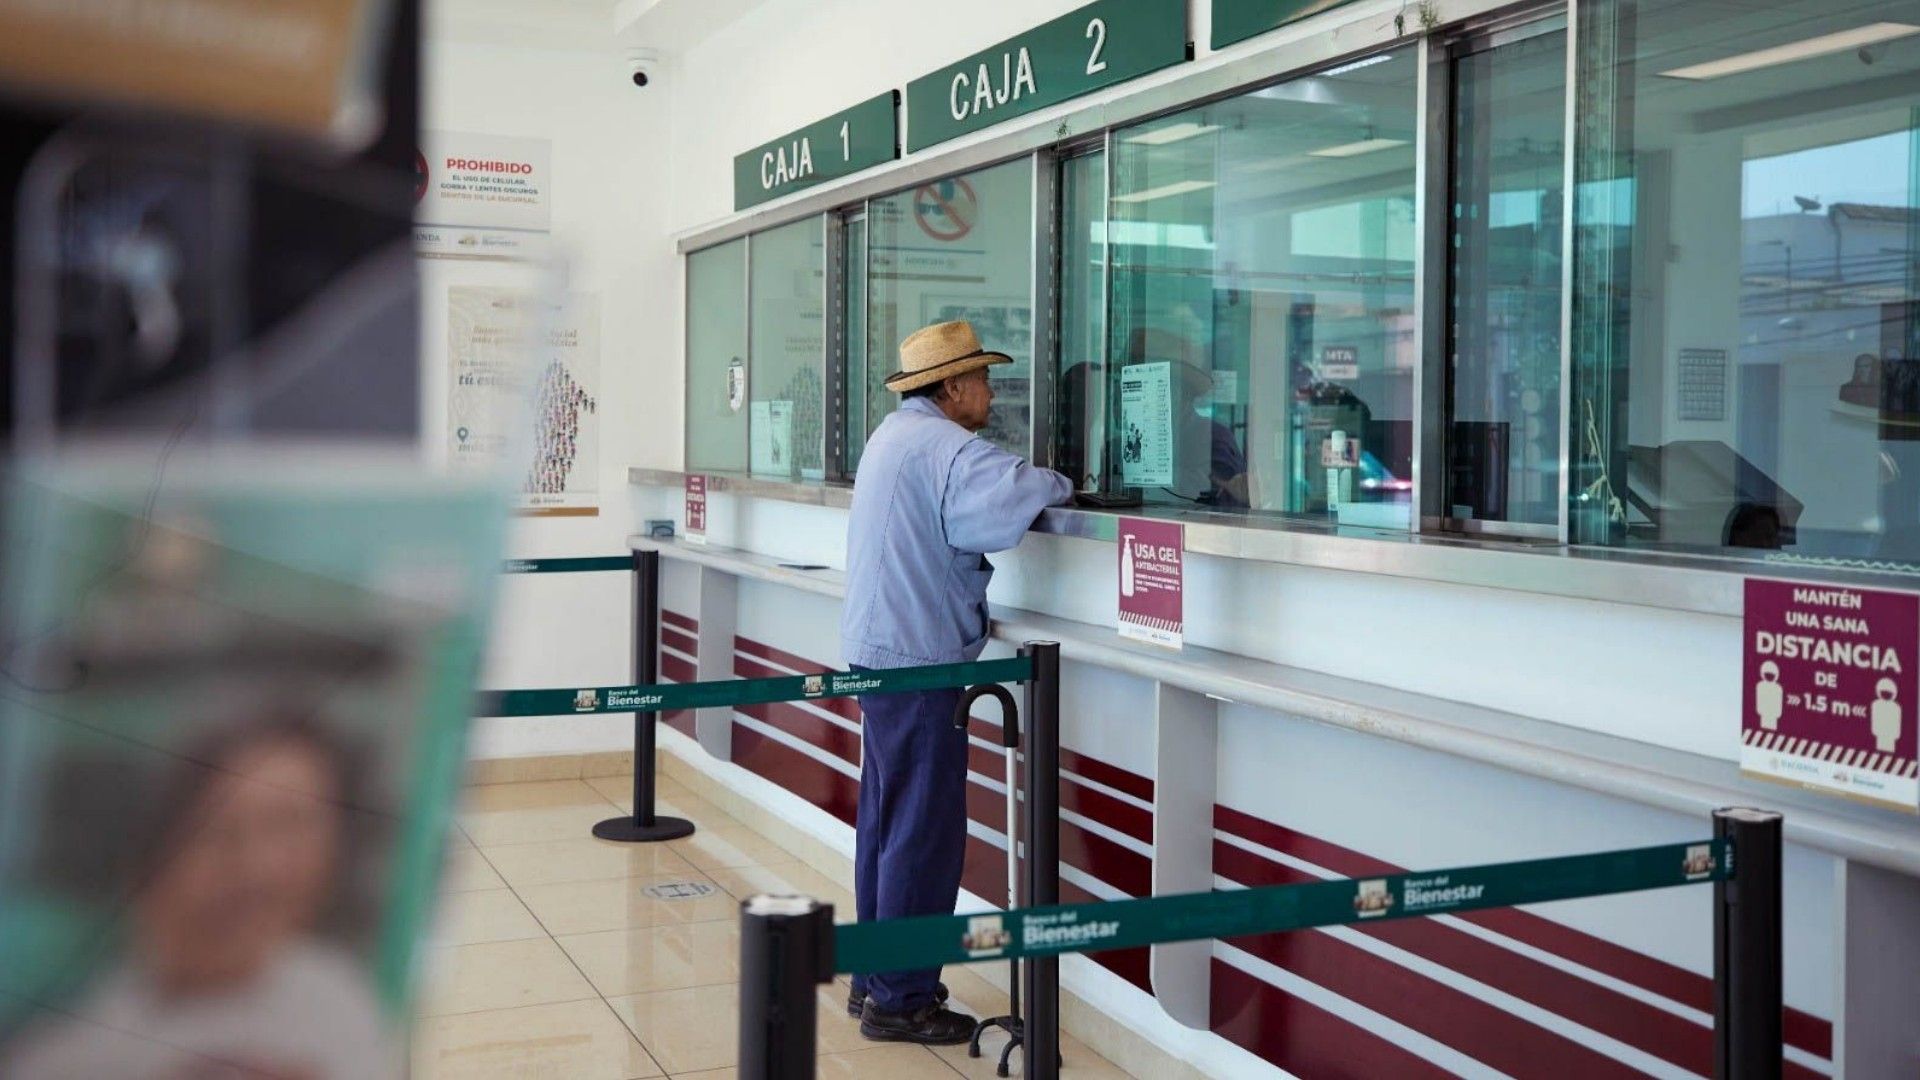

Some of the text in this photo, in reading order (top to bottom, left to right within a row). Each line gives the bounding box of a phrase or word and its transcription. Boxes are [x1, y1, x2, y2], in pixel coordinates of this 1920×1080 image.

[950, 18, 1107, 122] CAJA 2
[446, 158, 533, 174] PROHIBIDO
[761, 121, 851, 190] CAJA 1
[440, 183, 466, 191] GORRA
[475, 185, 502, 193] LENTES
[503, 187, 539, 195] OSCUROS
[1134, 543, 1180, 563] USA GEL
[1793, 588, 1862, 610] MANTÉN
[1786, 611, 1870, 635] UNA SANA
[1756, 631, 1902, 673] DISTANCIA
[833, 679, 882, 690] Bienestar
[1814, 671, 1838, 688] DE
[607, 695, 663, 706] Bienestar
[1804, 693, 1850, 717] 1.5 m
[1404, 884, 1485, 906] Bienestar
[1023, 921, 1120, 945] Bienestar
